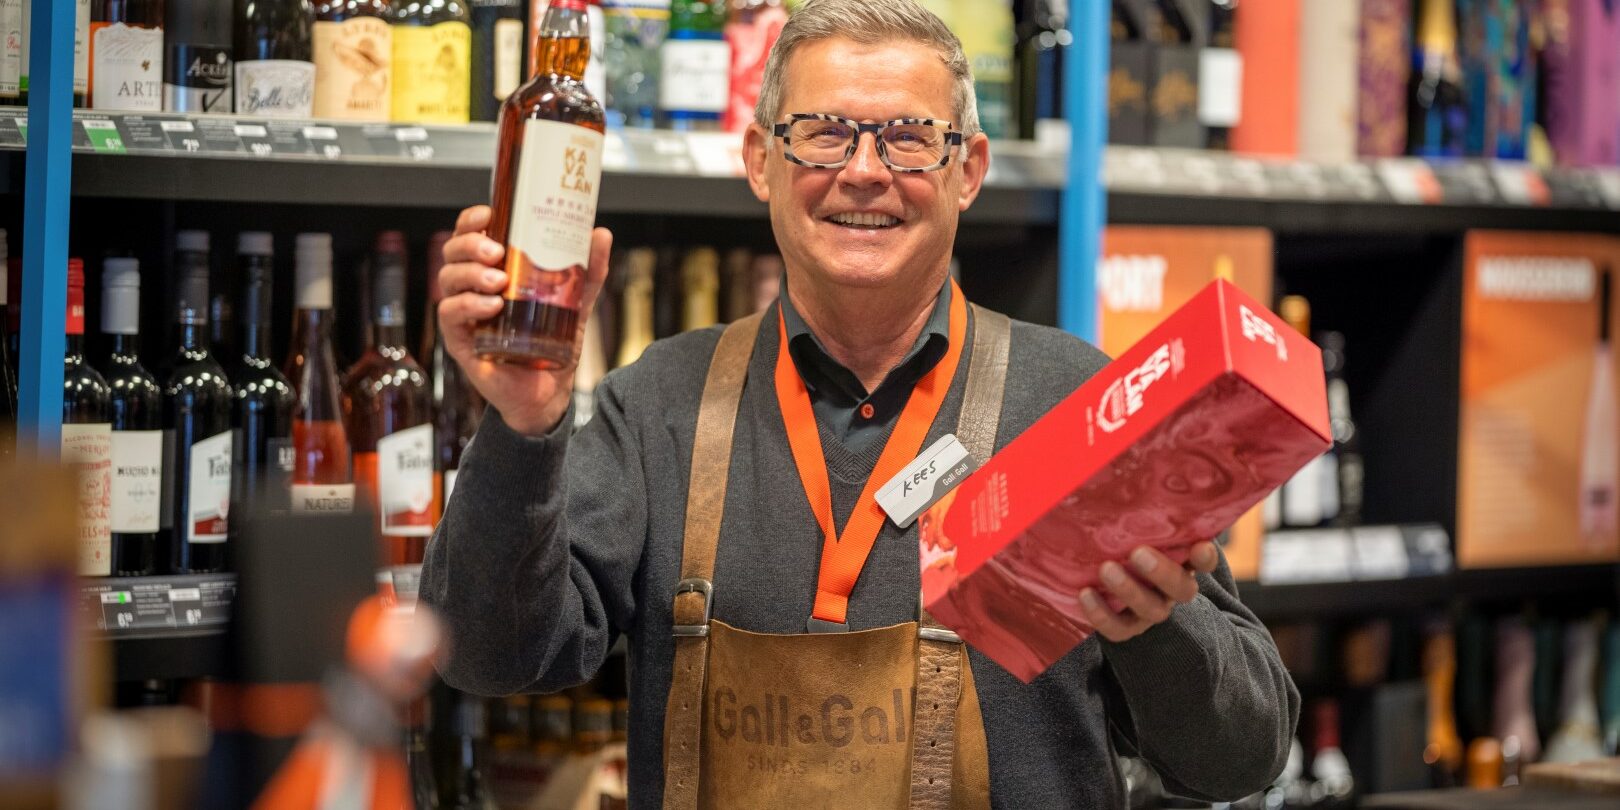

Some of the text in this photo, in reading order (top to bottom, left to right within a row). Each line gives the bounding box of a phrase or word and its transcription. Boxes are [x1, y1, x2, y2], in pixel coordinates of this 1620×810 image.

[903, 460, 936, 497] KEES
[942, 463, 969, 486] Gall Gall
